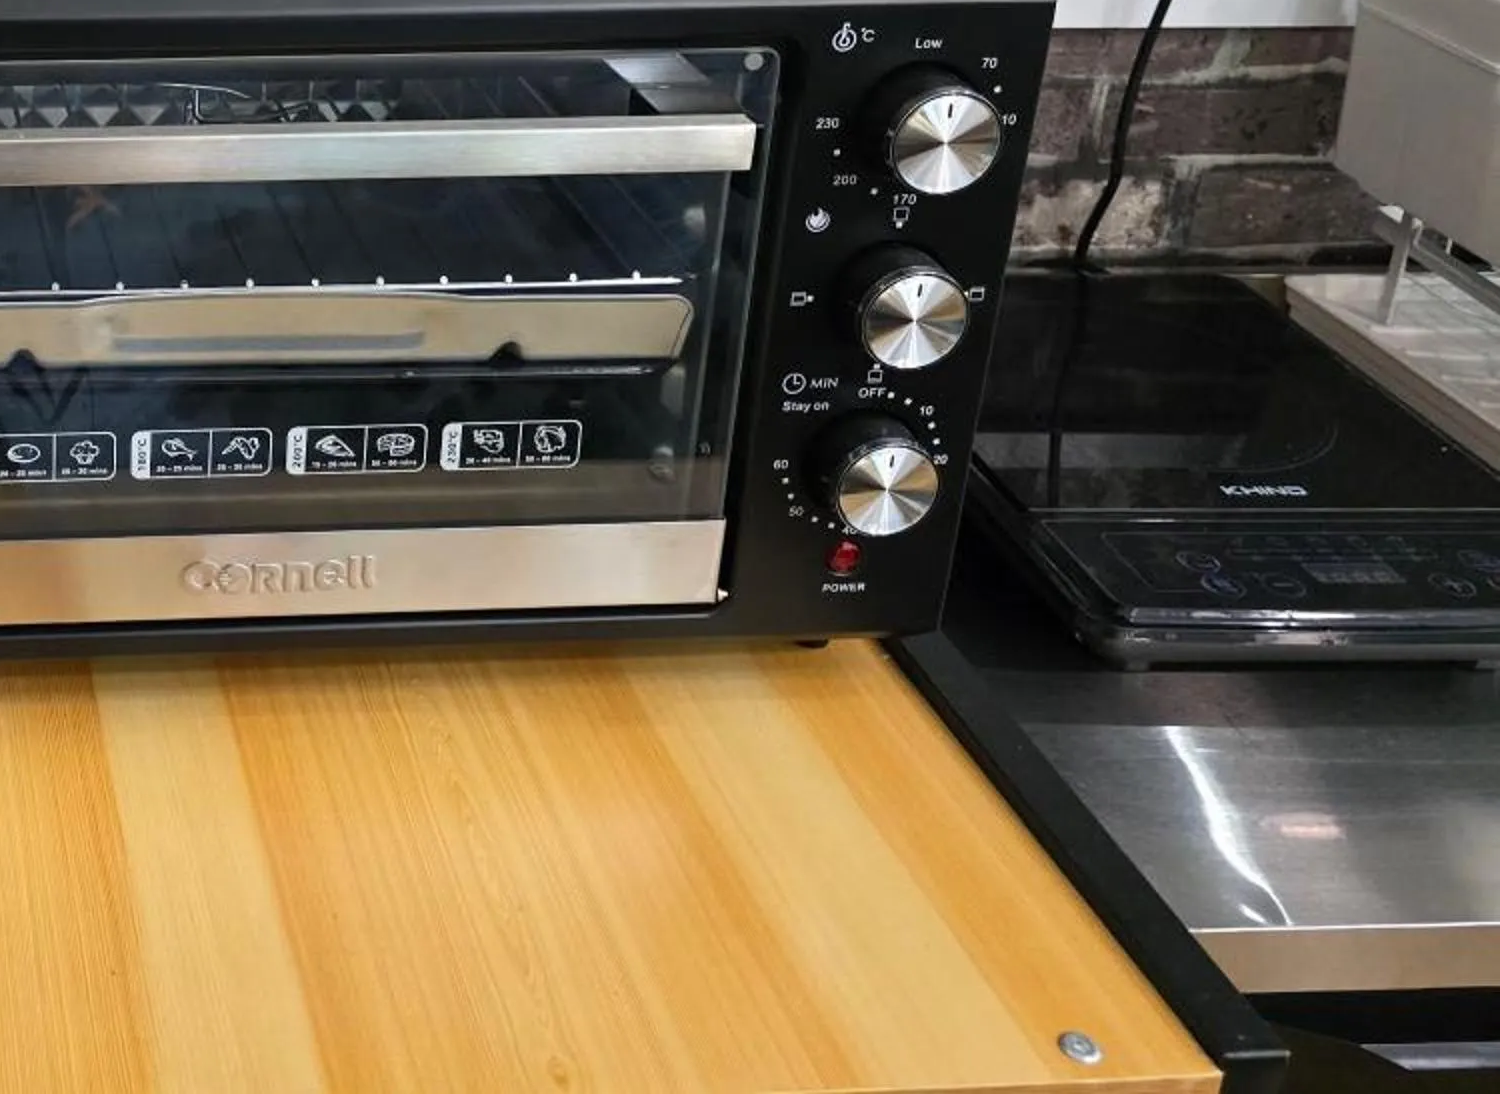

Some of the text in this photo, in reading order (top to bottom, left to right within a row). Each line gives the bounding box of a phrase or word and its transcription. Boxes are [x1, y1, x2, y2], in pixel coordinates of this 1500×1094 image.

[915, 37, 942, 50] Low
[981, 57, 998, 69] 70
[815, 117, 840, 129] 230
[832, 174, 857, 186] 200
[892, 193, 917, 205] 170
[809, 377, 839, 389] MIN
[858, 388, 886, 399] OFF
[781, 401, 830, 413] Stay on
[919, 405, 935, 416] 10
[773, 459, 789, 470] 60
[1220, 484, 1308, 496] KHIND
[788, 506, 805, 518] 50
[821, 582, 866, 593] POWER
